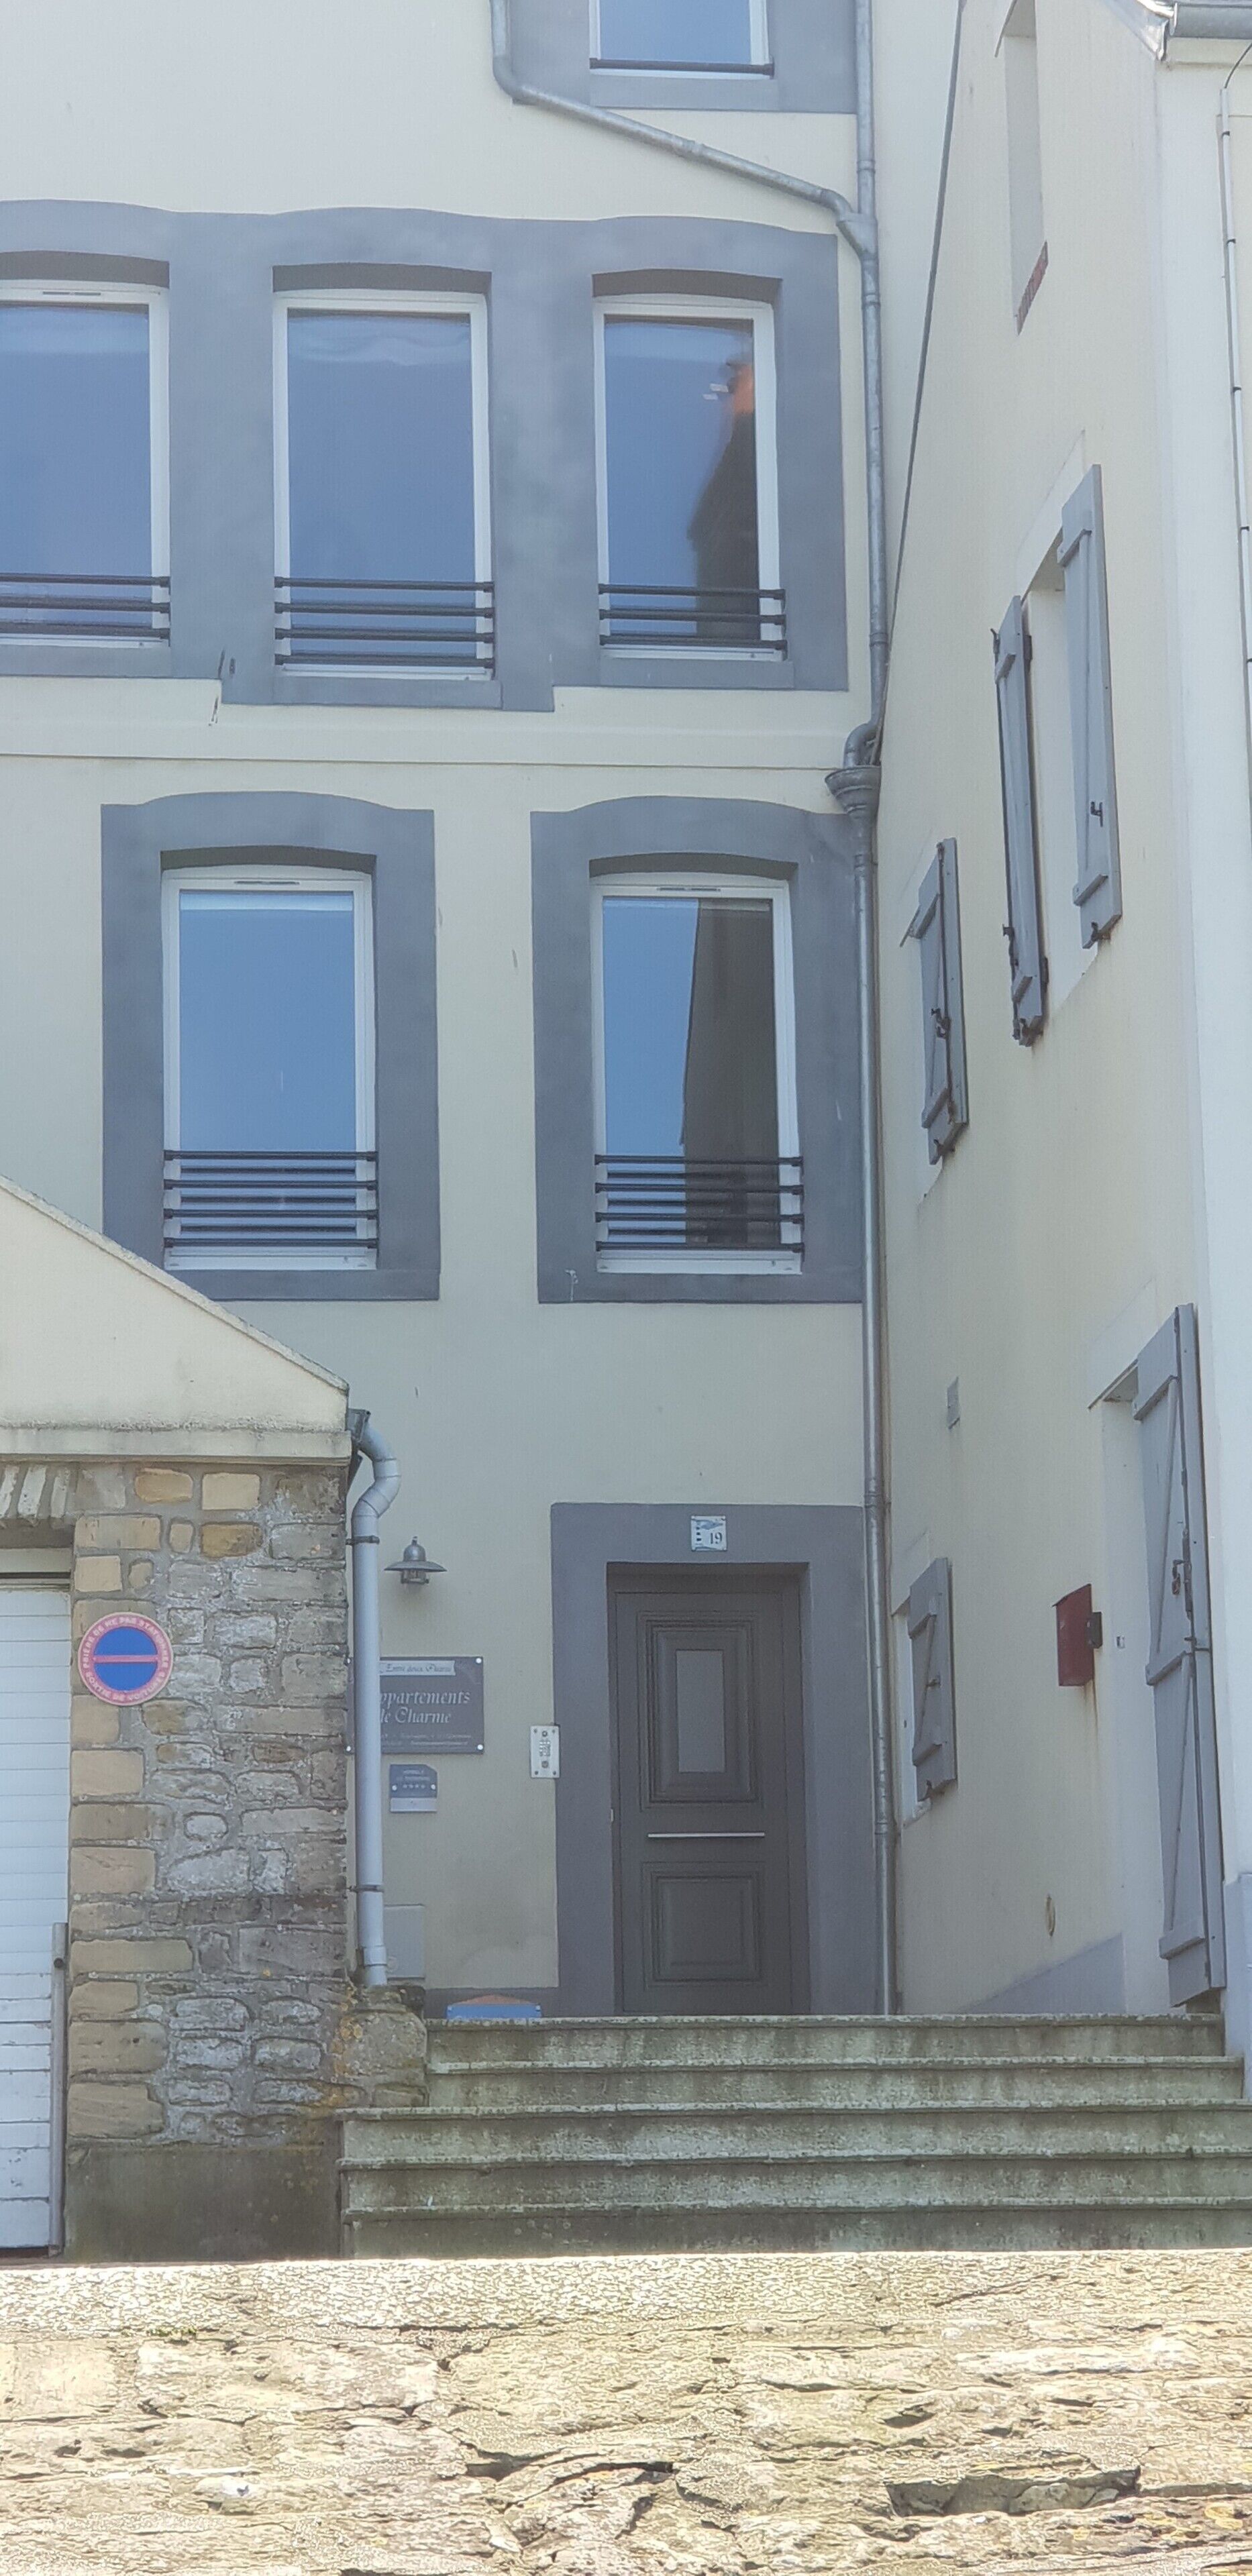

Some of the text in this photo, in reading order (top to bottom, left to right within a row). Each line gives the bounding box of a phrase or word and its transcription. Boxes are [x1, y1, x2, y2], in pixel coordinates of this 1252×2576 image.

[711, 1532, 722, 1544] 19
[93, 1625, 104, 1635] DE
[104, 1617, 118, 1627] NE
[118, 1617, 137, 1625] PAS
[85, 1672, 111, 1699] SORTIE
[112, 1693, 125, 1701] DE
[380, 1691, 470, 1709] ppartements
[395, 1707, 452, 1723] Charme
